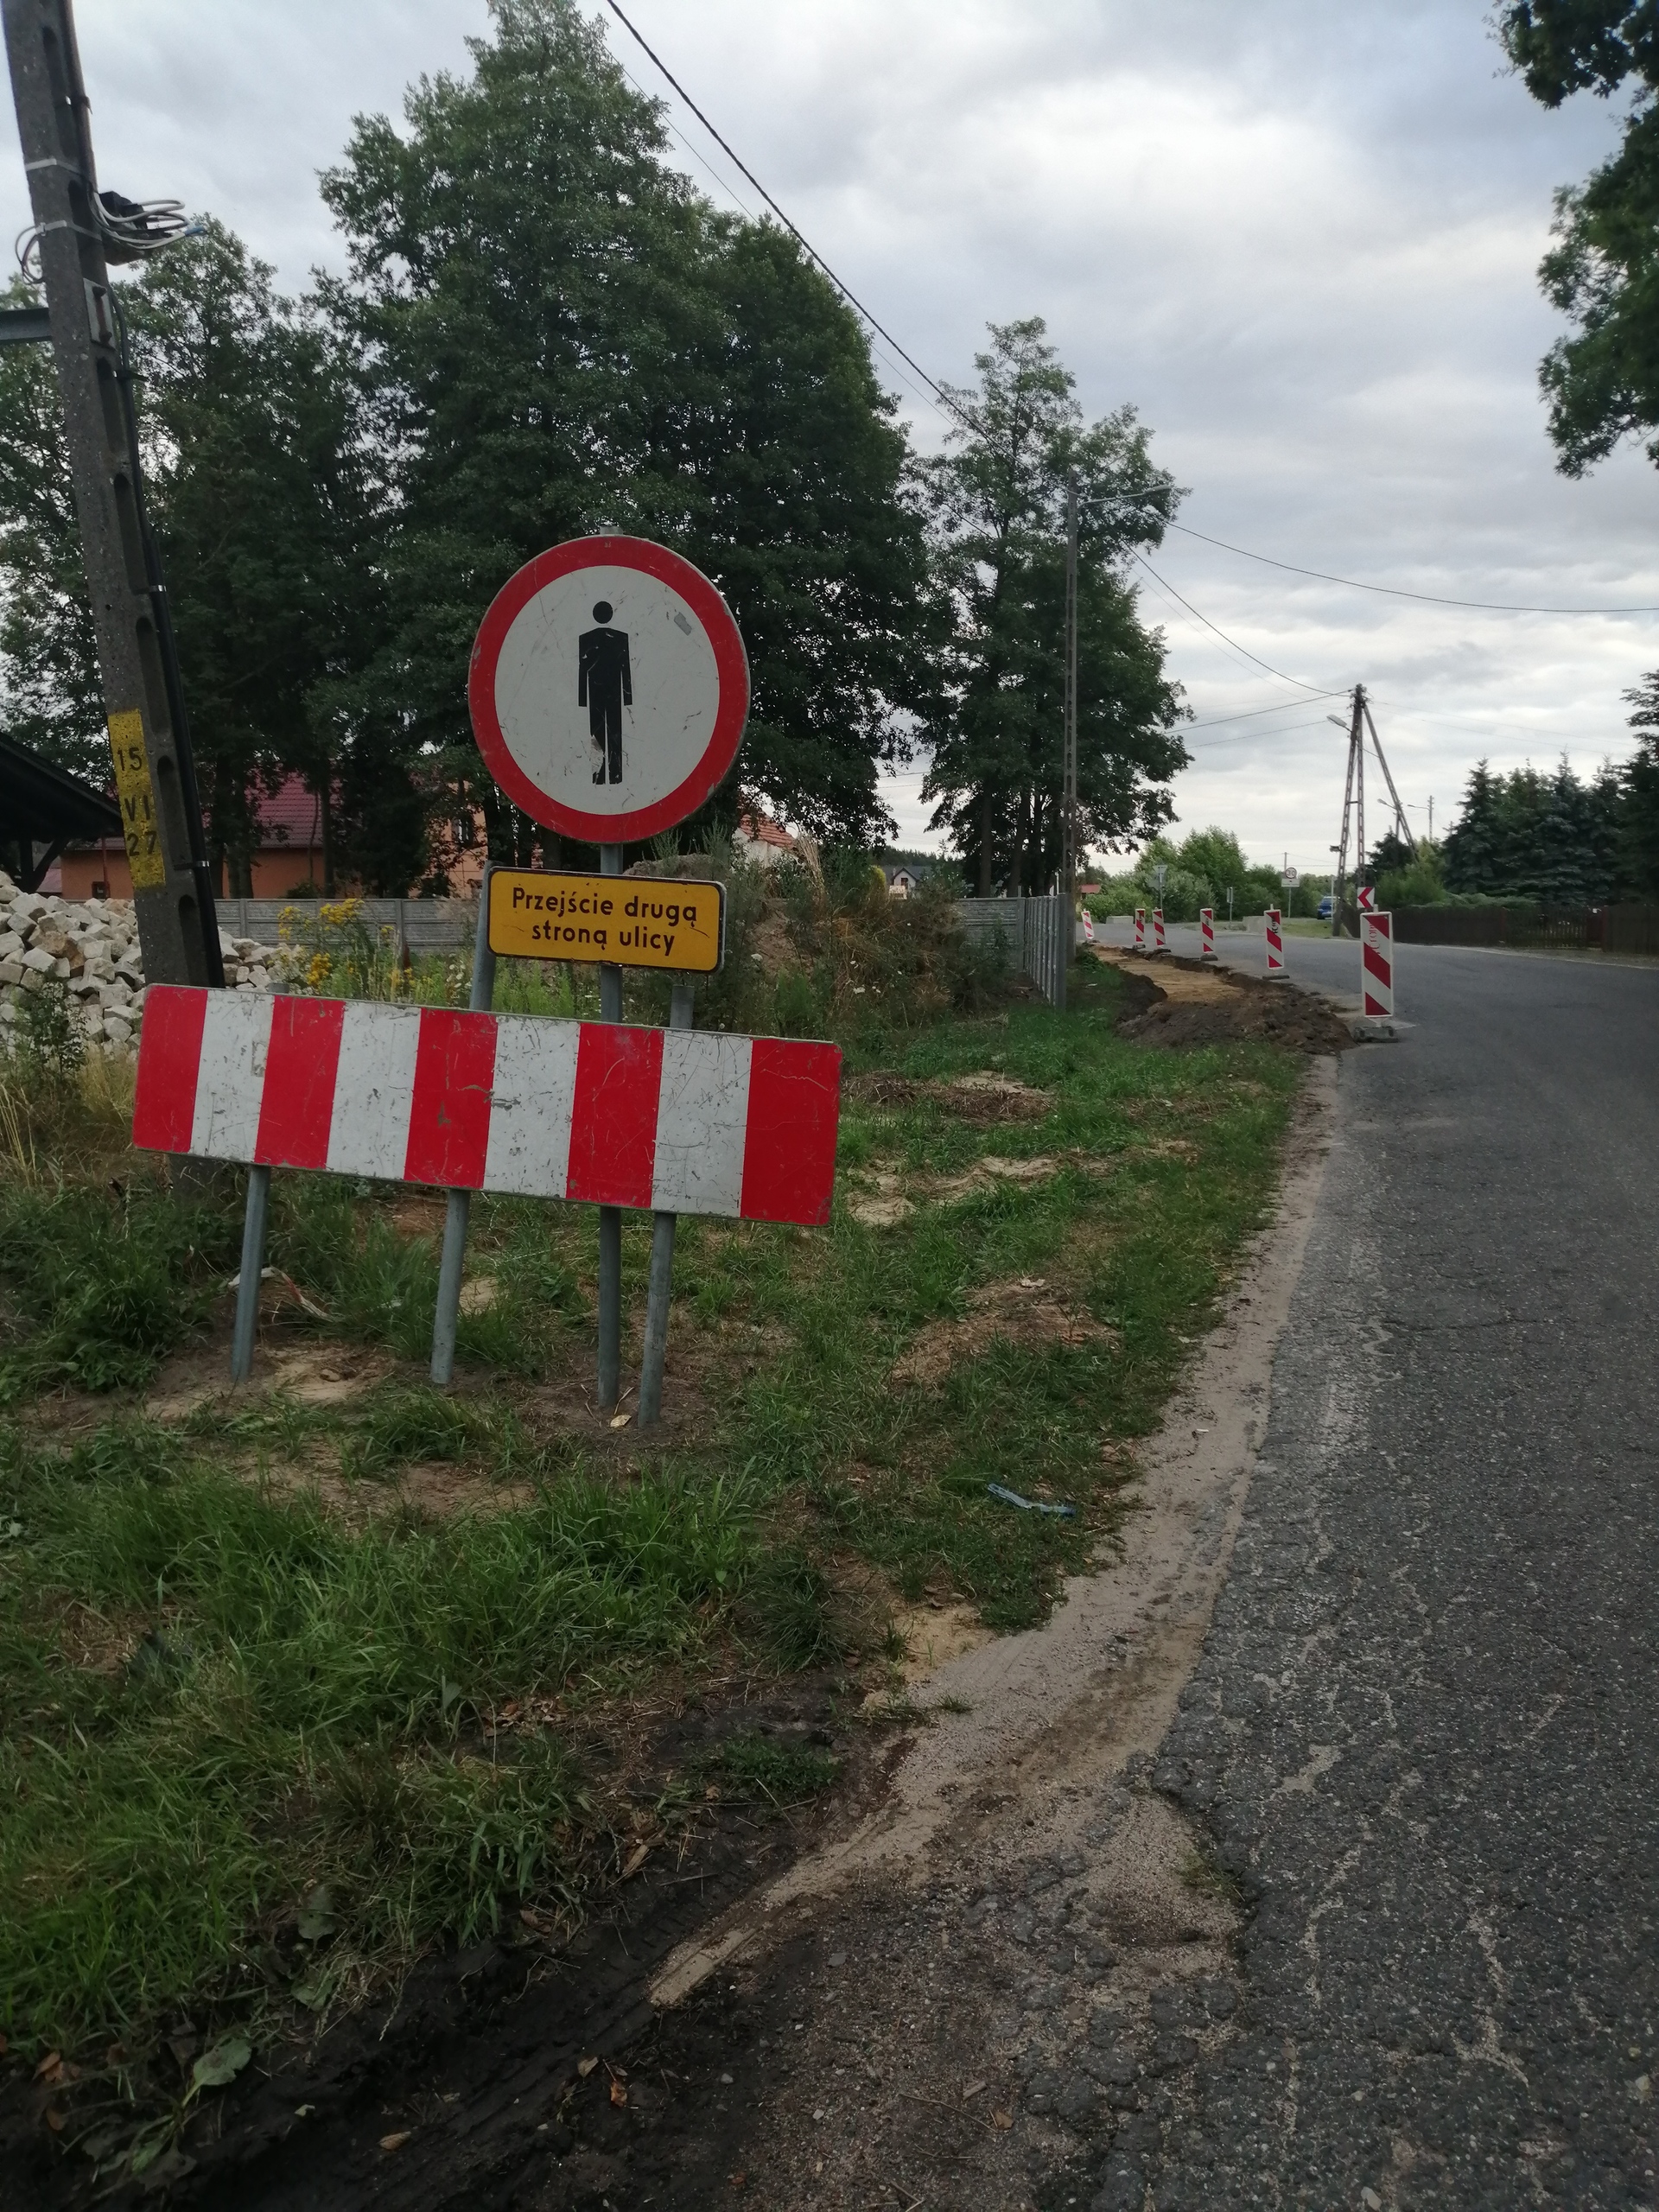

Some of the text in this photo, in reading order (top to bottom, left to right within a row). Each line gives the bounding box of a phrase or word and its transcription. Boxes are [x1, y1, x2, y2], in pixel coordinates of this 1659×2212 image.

[117, 747, 143, 772] 15
[124, 794, 151, 822] VI
[127, 830, 157, 856] 27
[512, 887, 697, 927] Przejście drugą
[531, 919, 675, 957] stroną ulicy
